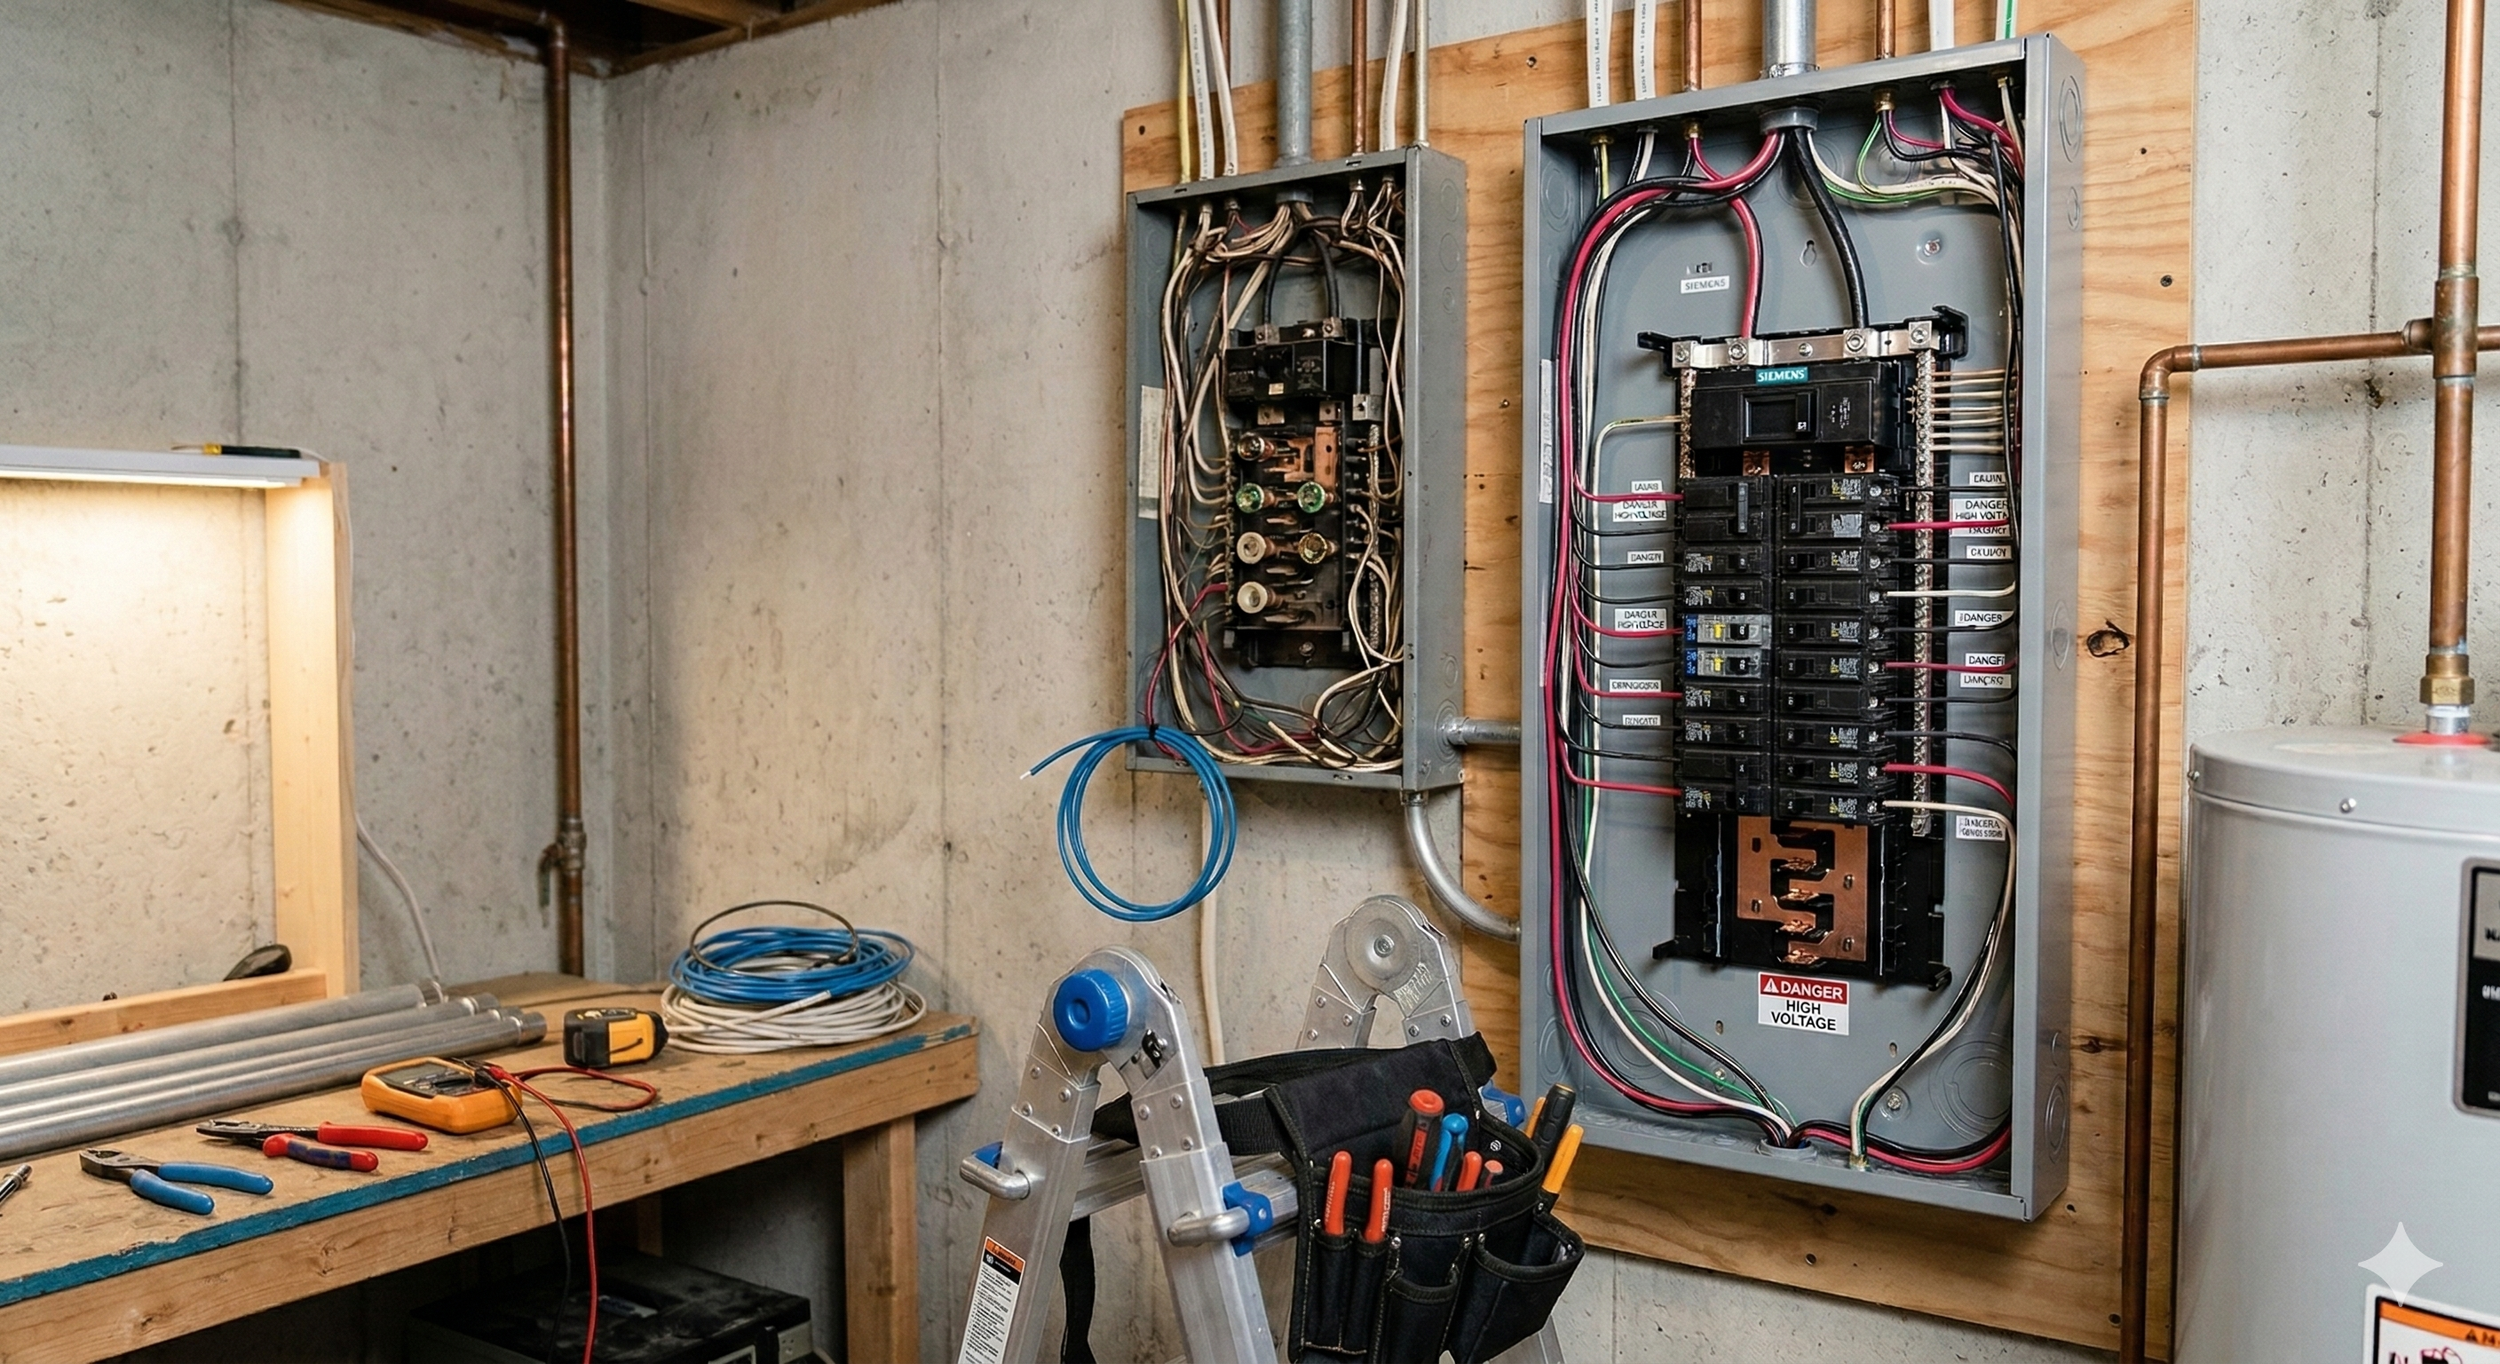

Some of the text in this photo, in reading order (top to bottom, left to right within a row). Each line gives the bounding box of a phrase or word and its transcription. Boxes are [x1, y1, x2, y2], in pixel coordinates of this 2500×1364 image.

[1758, 369, 1805, 382] SIEMENS
[1964, 613, 2003, 623] DANGER
[1781, 980, 1844, 1001] DANGER
[1786, 1000, 1821, 1015] HIGH
[1771, 1011, 1837, 1031] VOLTAGE
